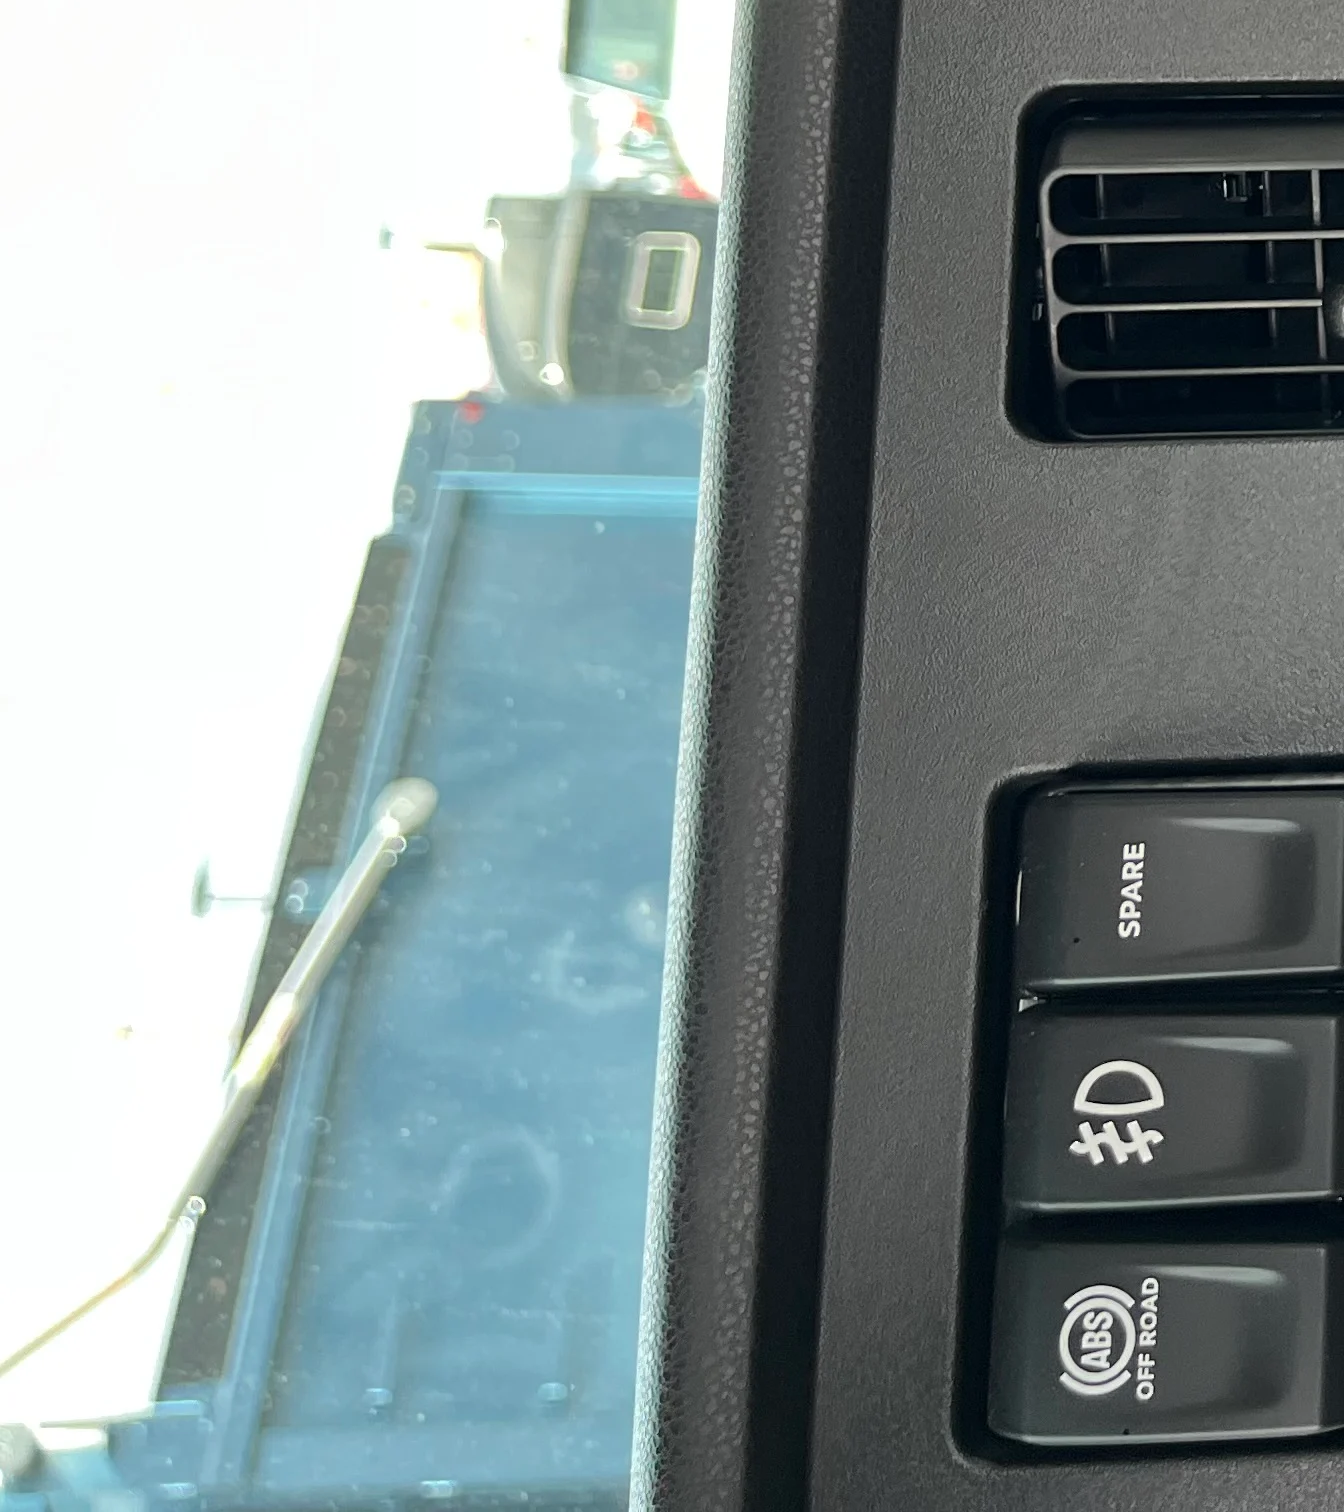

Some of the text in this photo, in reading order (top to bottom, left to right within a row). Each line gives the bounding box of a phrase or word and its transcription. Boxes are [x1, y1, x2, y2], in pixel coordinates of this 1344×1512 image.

[1117, 841, 1147, 940] SPARE
[1080, 1310, 1115, 1370] ABS
[1135, 1275, 1160, 1402] OFF ROAD
